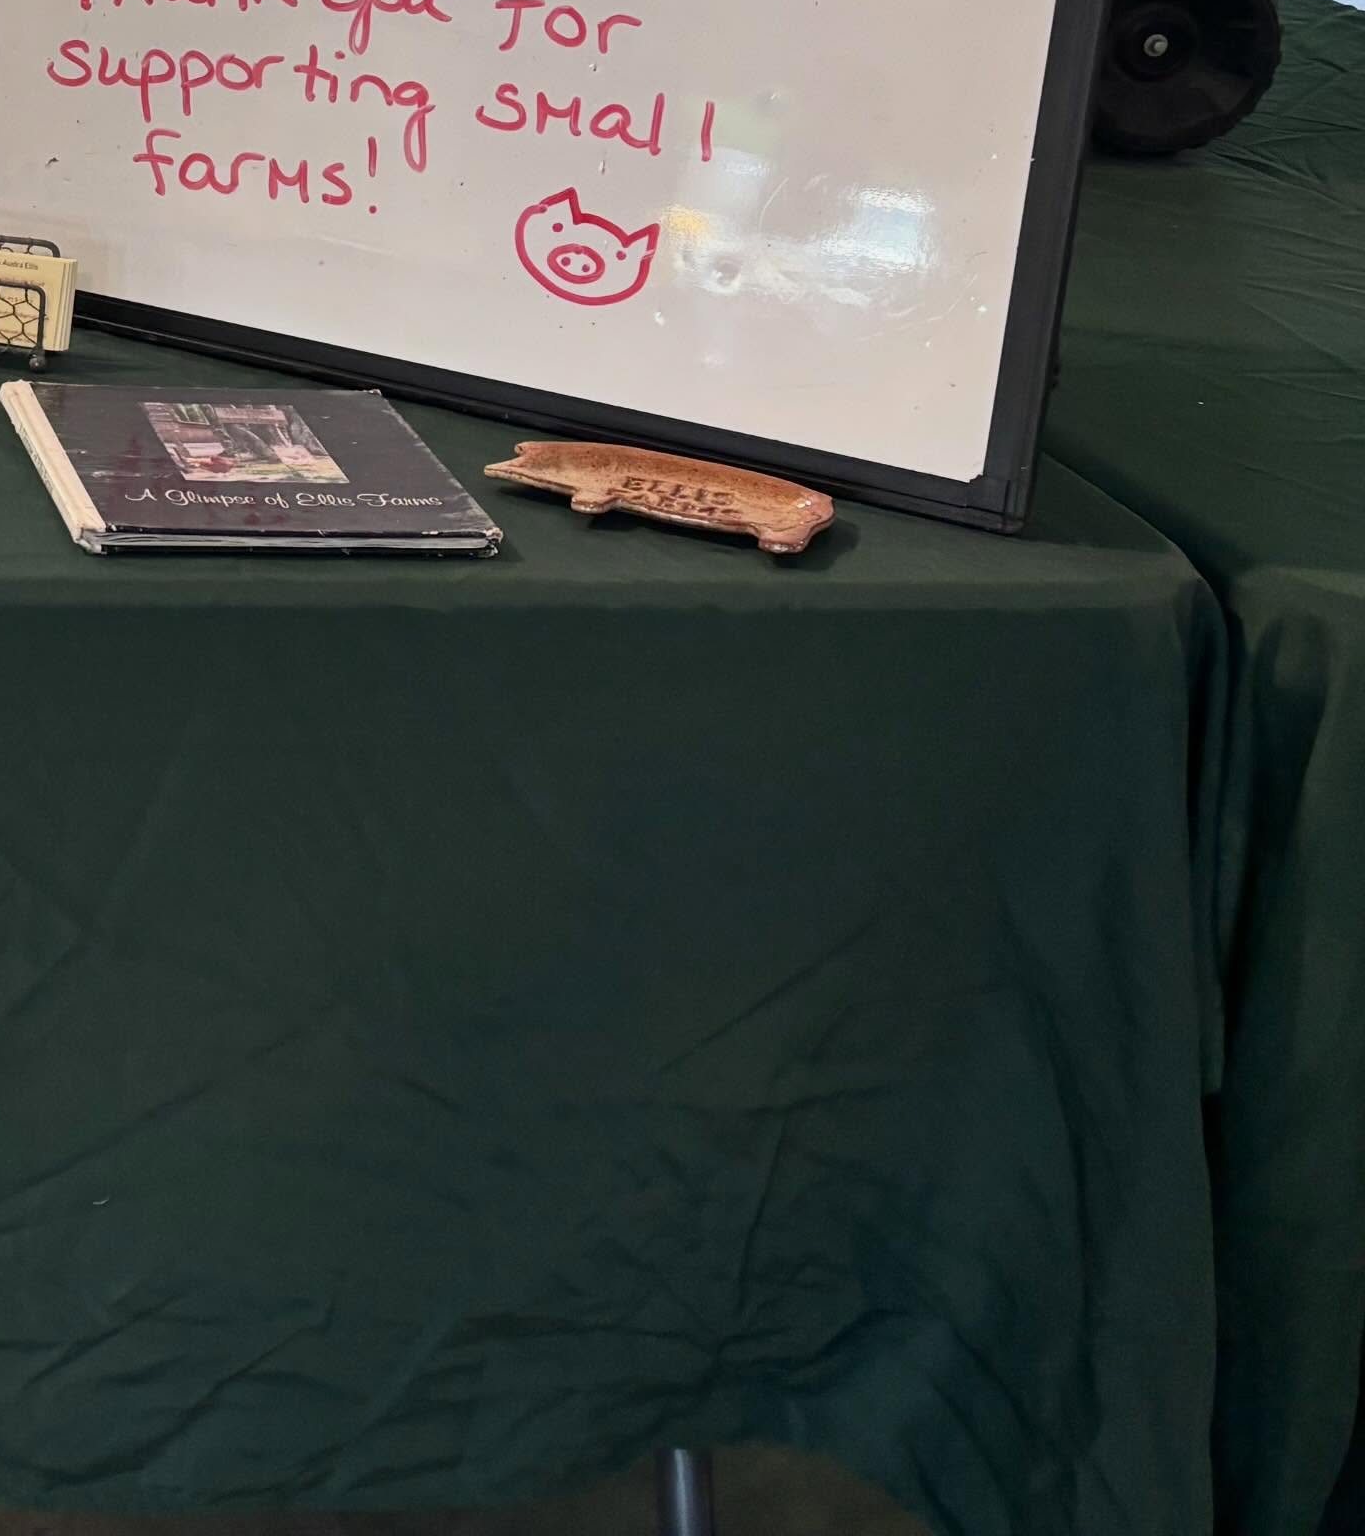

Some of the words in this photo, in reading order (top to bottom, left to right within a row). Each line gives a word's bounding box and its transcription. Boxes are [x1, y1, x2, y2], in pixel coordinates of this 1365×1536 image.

[47, 38, 435, 173] supporting
[125, 487, 157, 503] A
[165, 488, 256, 507] Glimpse
[264, 489, 290, 509] of
[298, 491, 355, 508] Ellis
[355, 492, 443, 508] Farms
